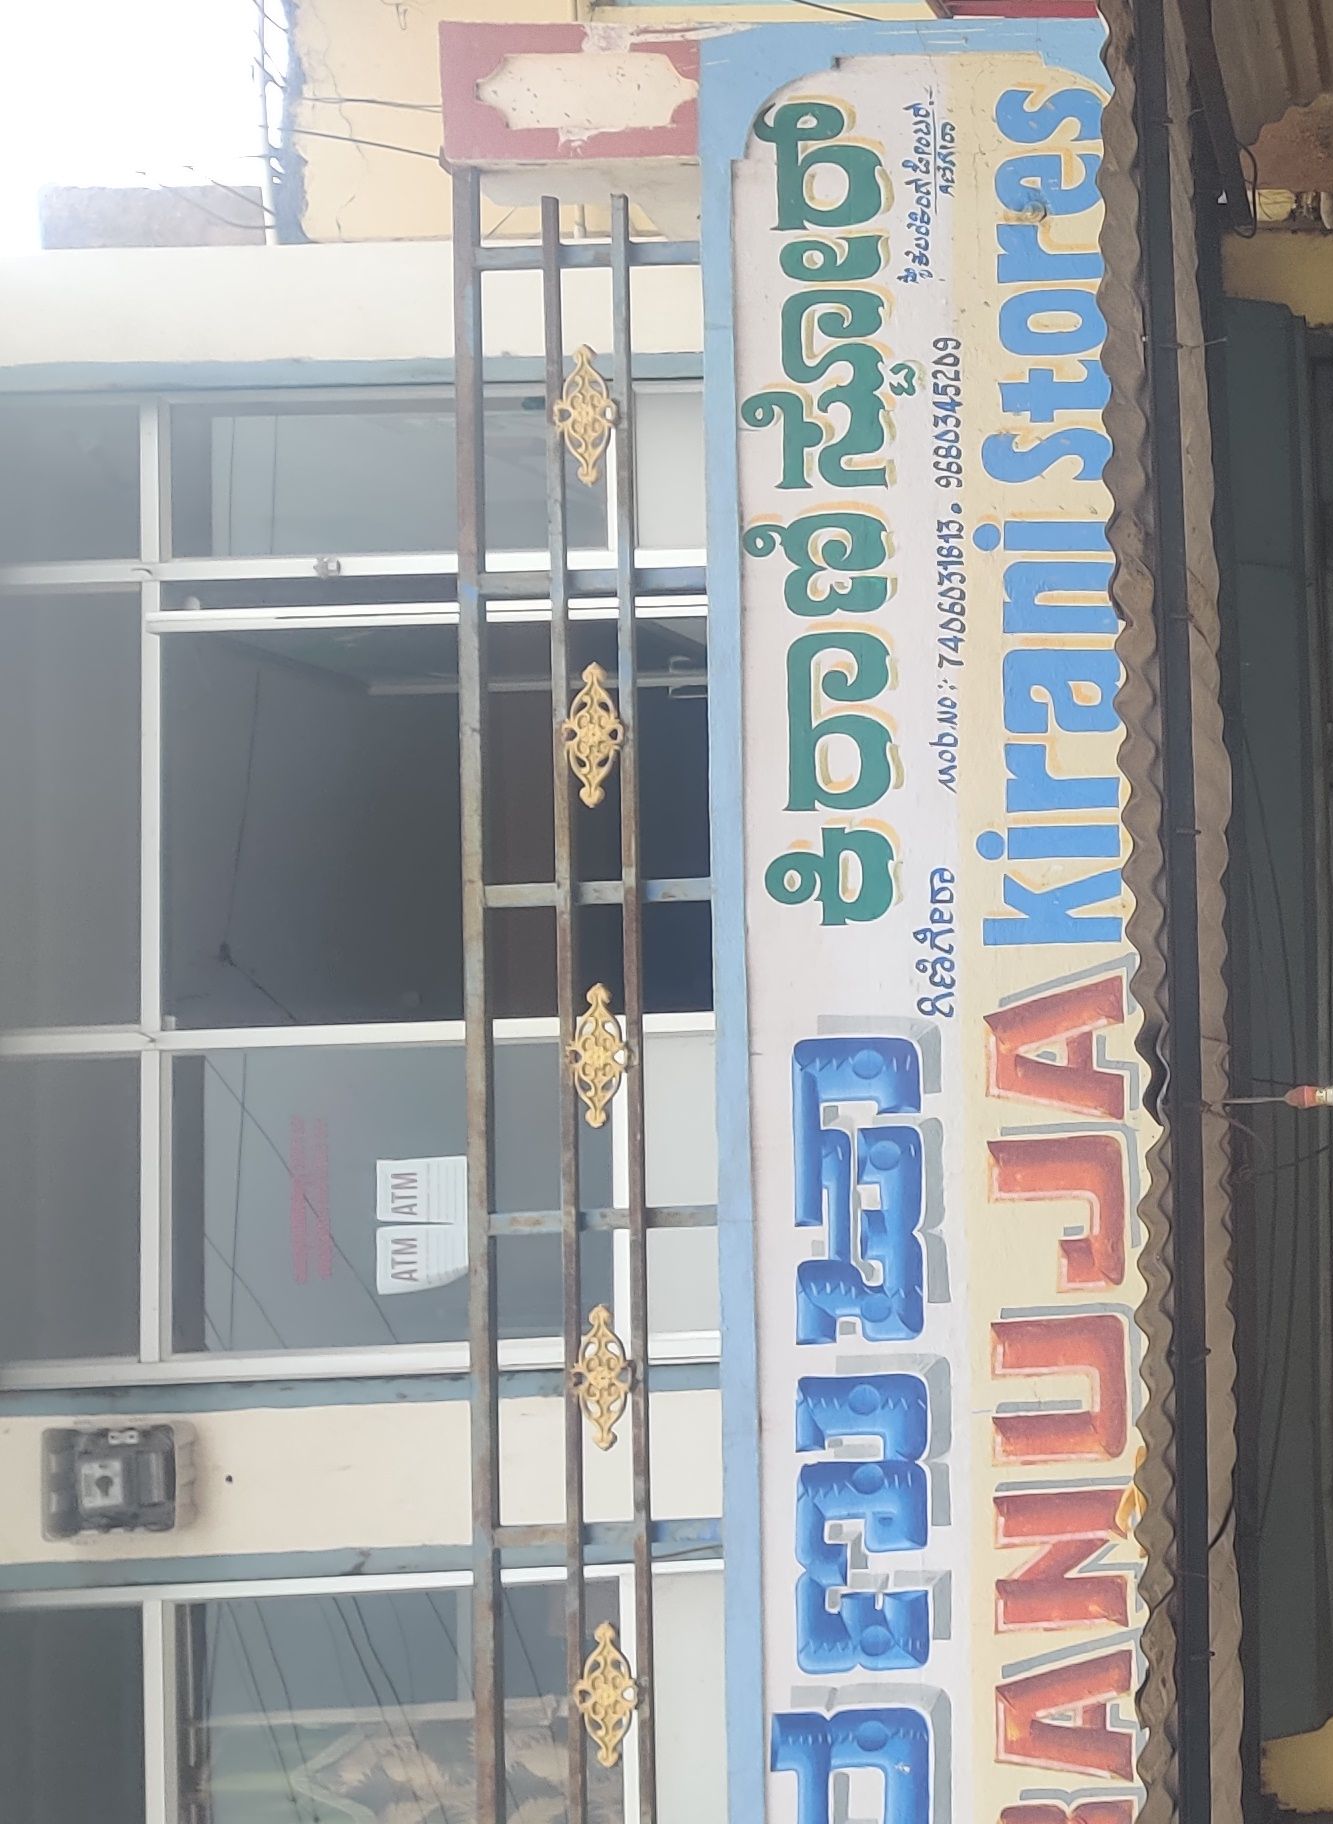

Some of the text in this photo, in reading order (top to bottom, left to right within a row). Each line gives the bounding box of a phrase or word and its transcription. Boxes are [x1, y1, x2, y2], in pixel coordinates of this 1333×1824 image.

[980, 87, 1112, 482] Stores
[932, 336, 963, 489] 9680345209
[390, 1172, 418, 1216] ATM
[390, 1237, 419, 1282] ATM
